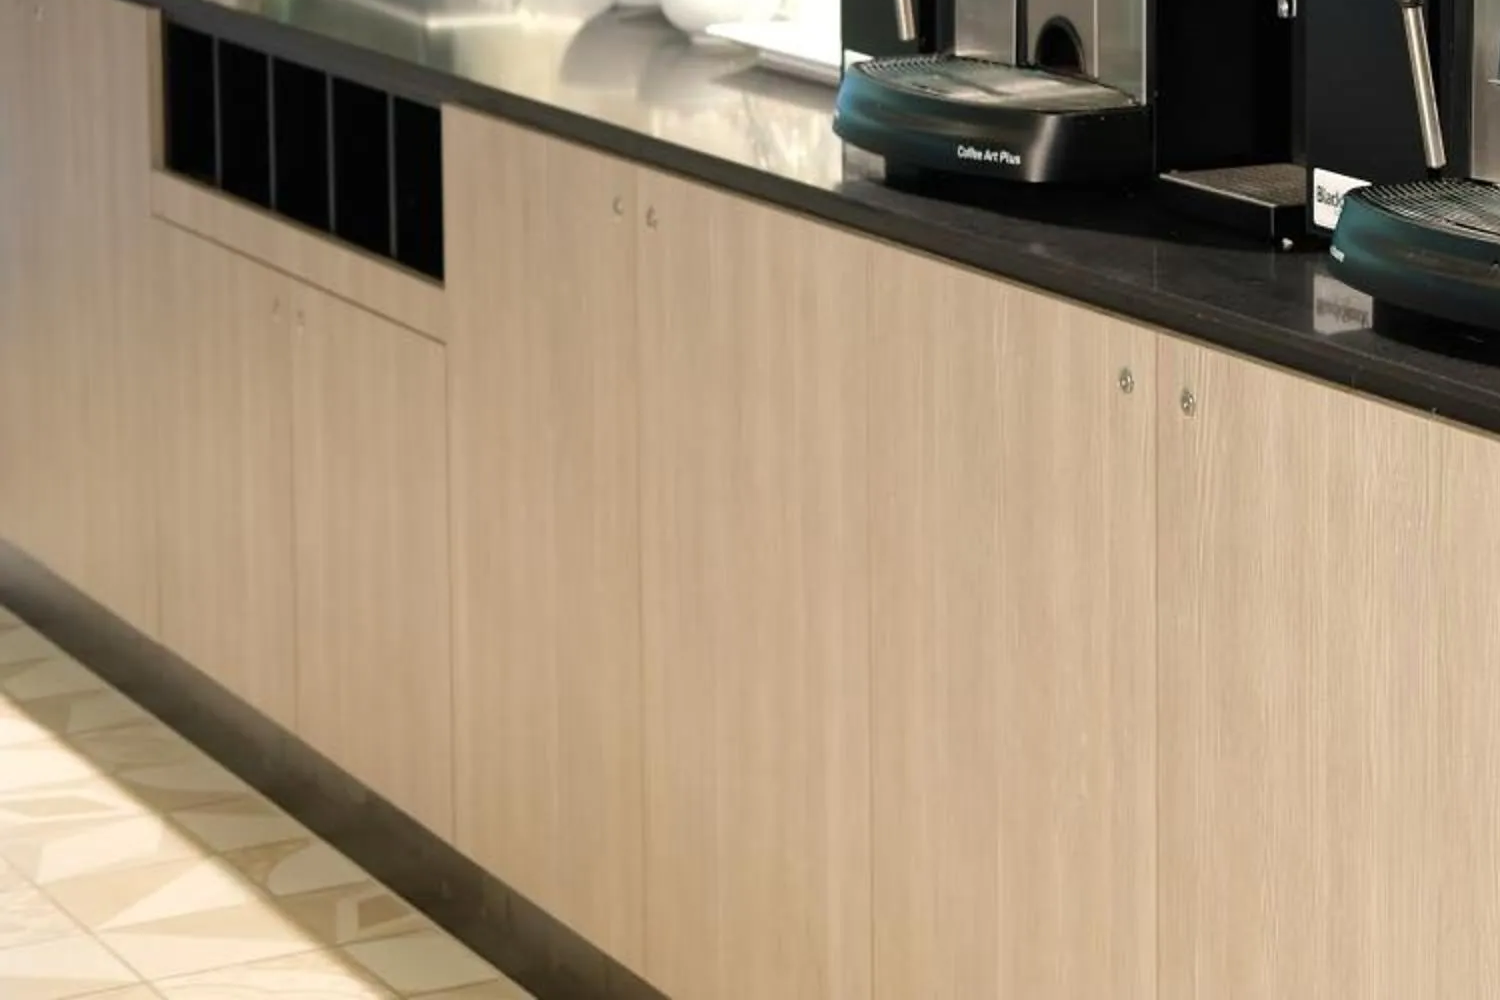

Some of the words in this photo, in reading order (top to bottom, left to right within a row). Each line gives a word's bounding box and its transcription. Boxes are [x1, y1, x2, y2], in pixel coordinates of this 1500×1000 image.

[957, 144, 982, 161] Coffee
[983, 149, 998, 163] Art
[1000, 150, 1021, 165] Plus
